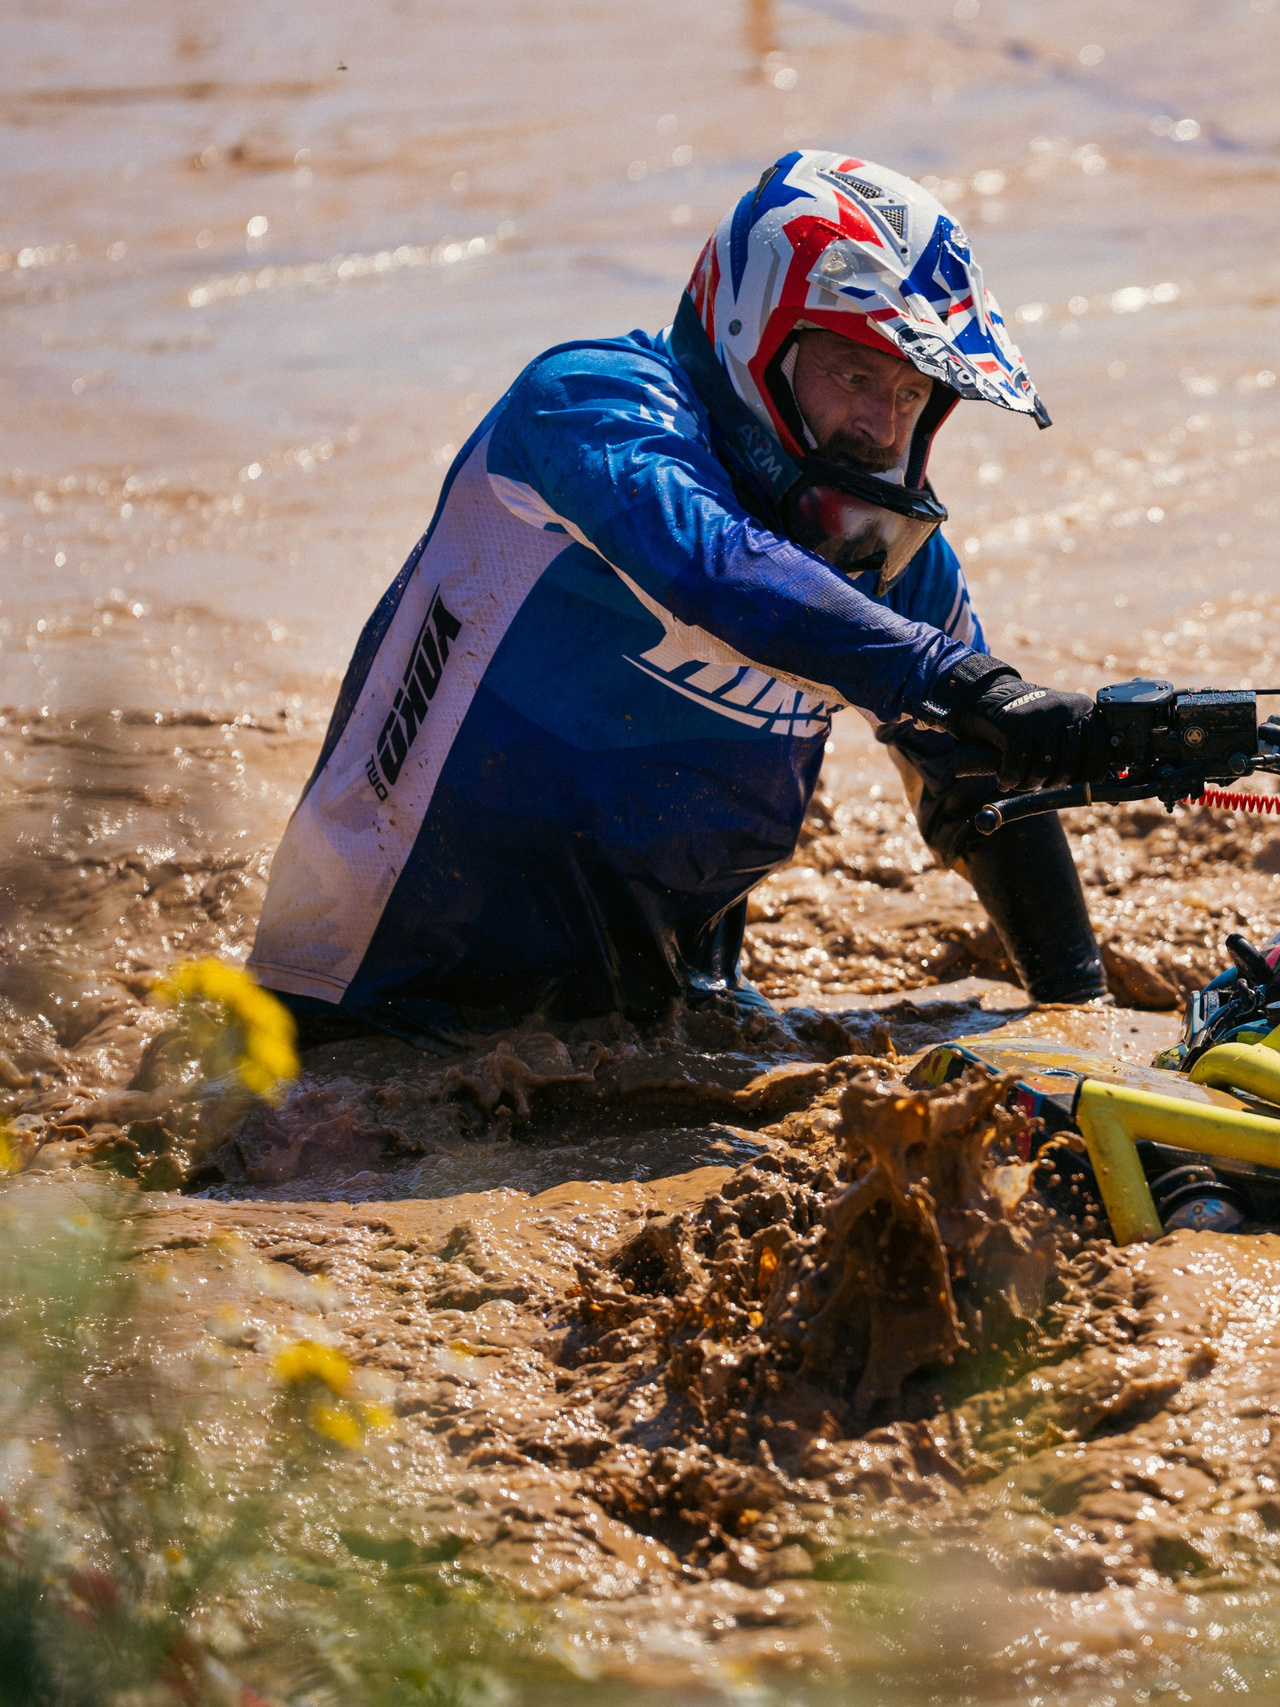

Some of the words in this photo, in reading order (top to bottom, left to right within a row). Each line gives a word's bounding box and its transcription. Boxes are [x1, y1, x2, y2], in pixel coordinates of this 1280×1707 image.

[376, 588, 463, 787] YOKO
[1002, 690, 1047, 712] YOKO
[365, 754, 389, 801] TWO
